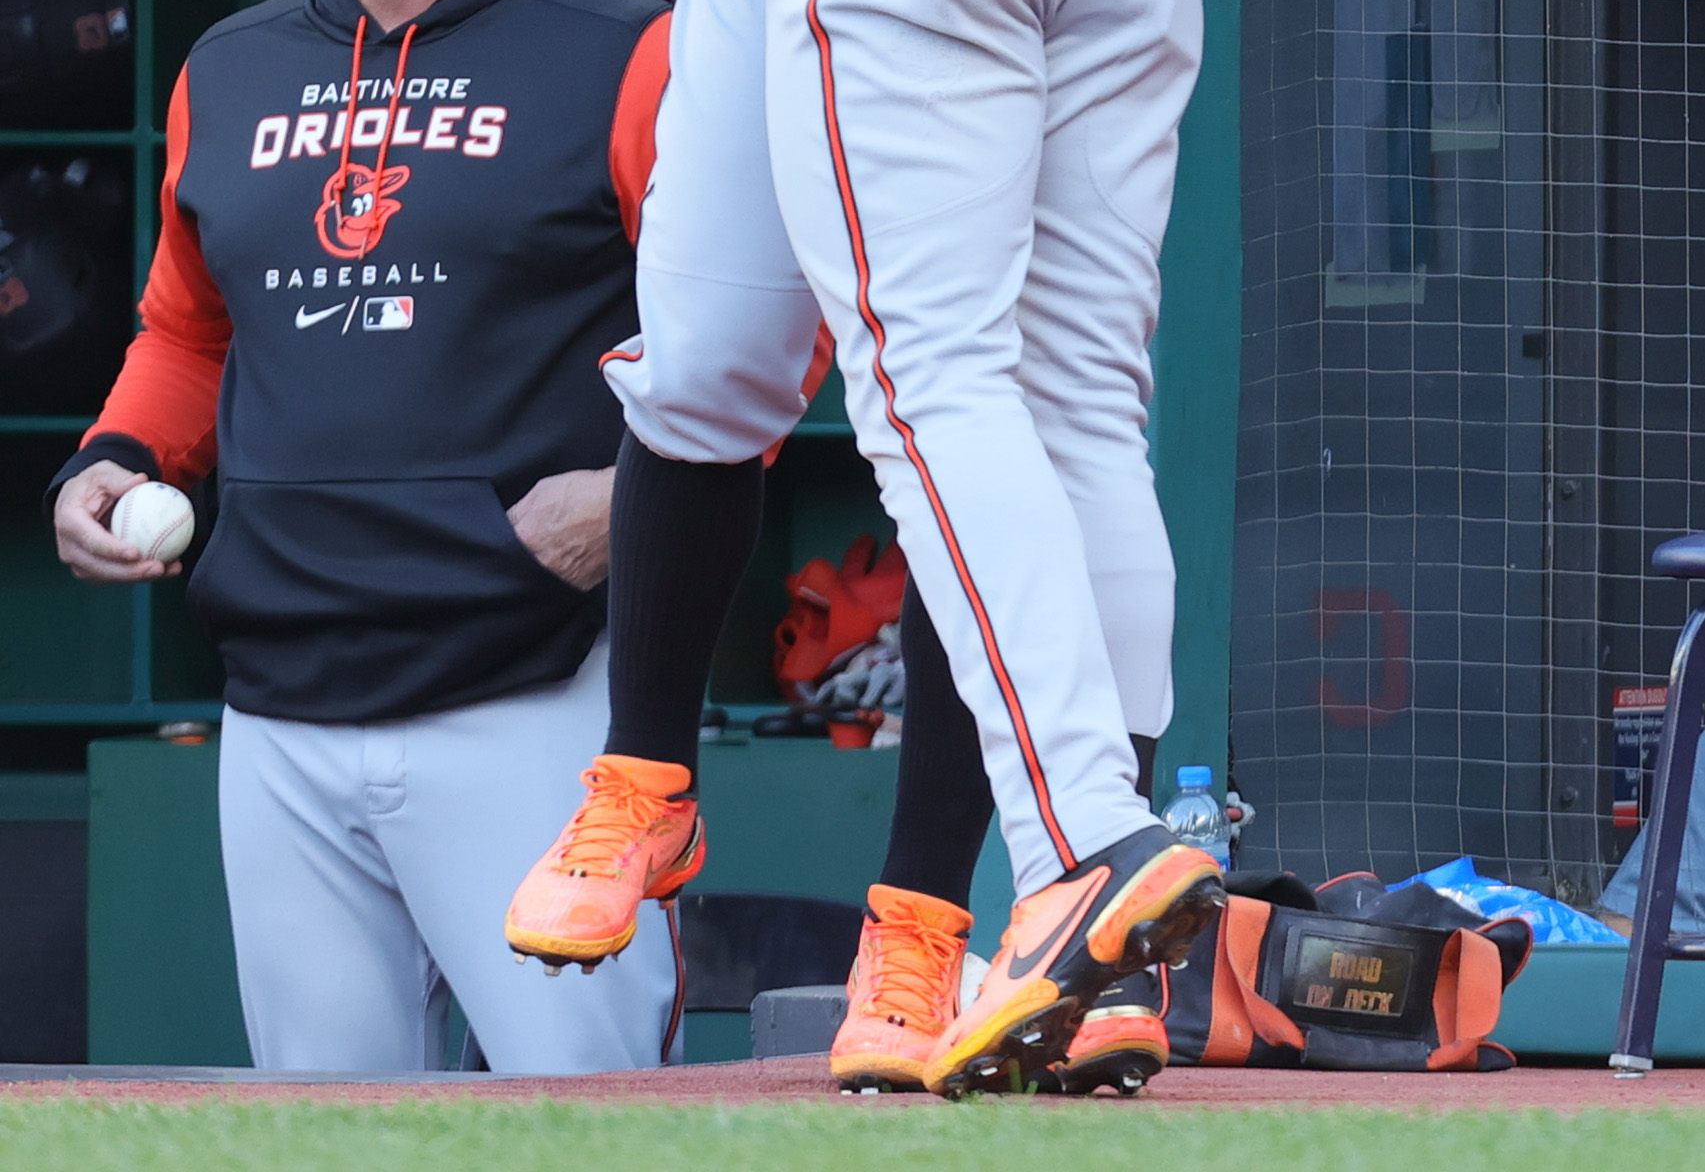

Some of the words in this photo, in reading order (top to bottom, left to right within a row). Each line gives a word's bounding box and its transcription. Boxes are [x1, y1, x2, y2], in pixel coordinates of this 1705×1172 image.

[301, 77, 472, 107] BALTIMORE
[250, 105, 508, 170] ORIOLES
[265, 261, 449, 290] BASEBALL
[1329, 952, 1382, 984] ROAD
